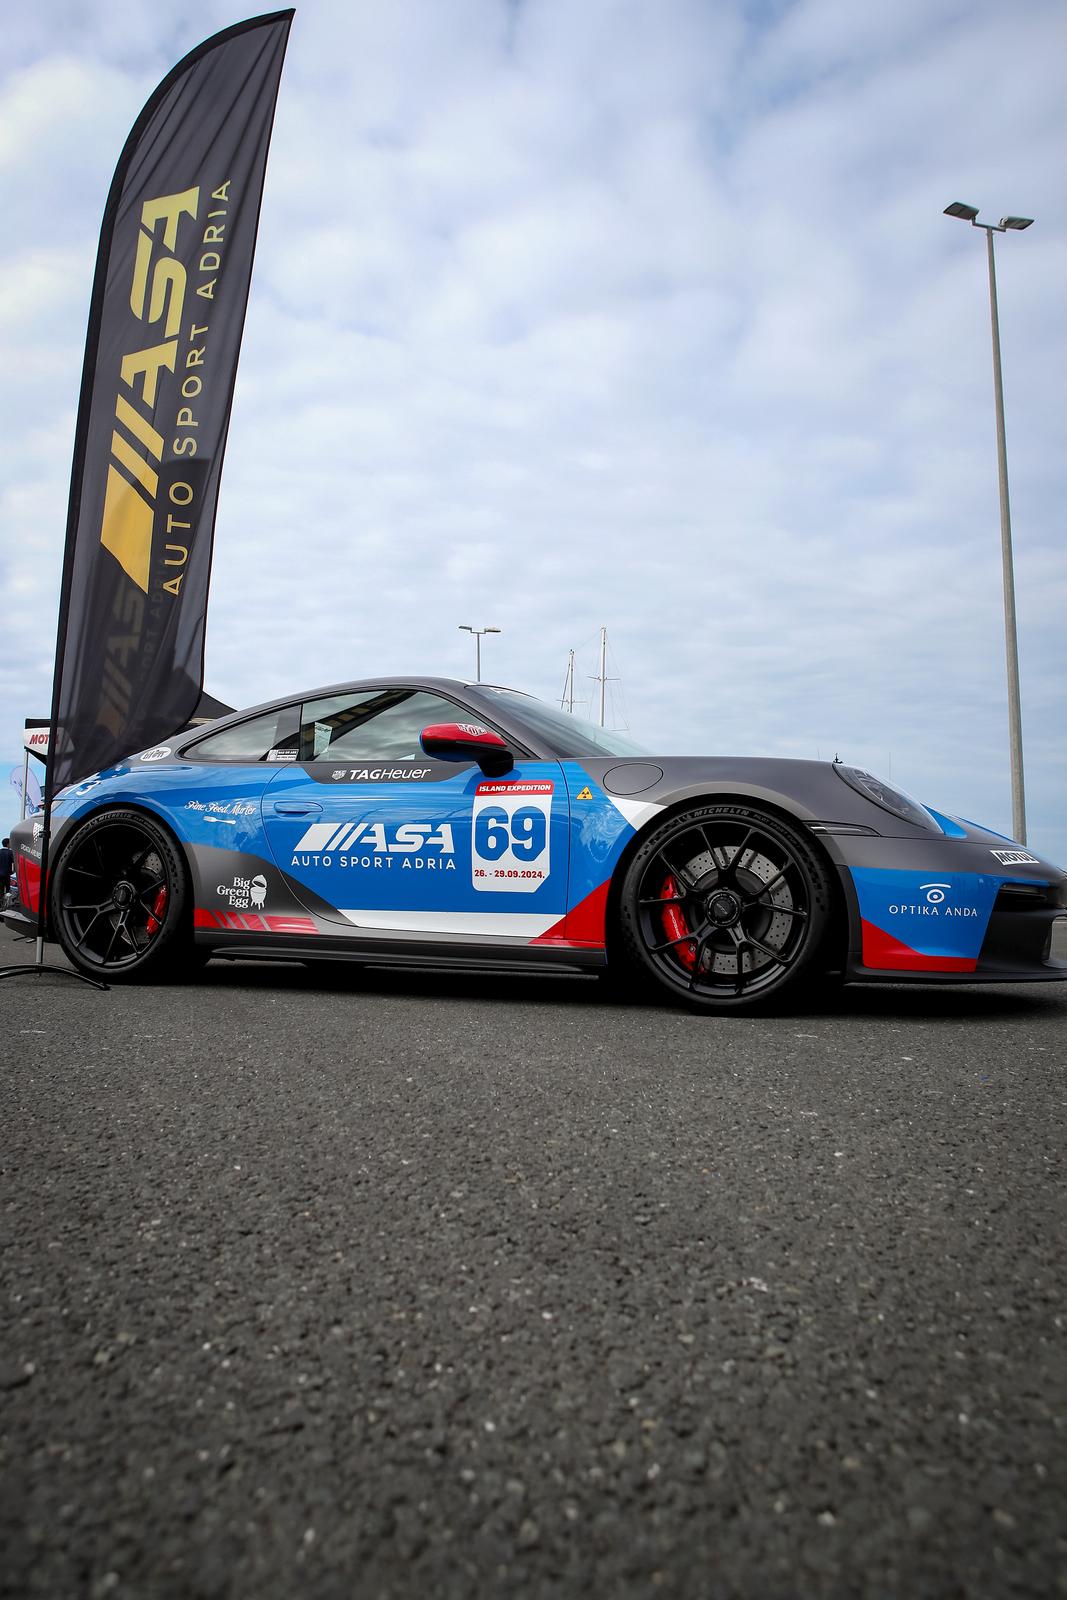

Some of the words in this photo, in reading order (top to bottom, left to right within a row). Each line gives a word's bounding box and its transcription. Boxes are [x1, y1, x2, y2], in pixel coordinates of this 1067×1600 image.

[196, 179, 231, 299] ADRIA
[172, 323, 209, 457] SPORT
[162, 481, 194, 596] AUTO
[29, 734, 51, 745] MOT
[694, 806, 750, 817] MICHELIN
[359, 822, 455, 853] ASA
[474, 805, 547, 862] 69
[291, 855, 332, 867] AUTO
[340, 856, 394, 868] SPORT
[402, 857, 456, 870] ADRIA
[995, 851, 1036, 863] MOTUL
[474, 869, 487, 877] 26.
[494, 870, 545, 879] 29.09.2024.
[233, 876, 250, 890] Big
[216, 885, 250, 897] Green
[229, 896, 249, 909] Egg
[888, 905, 939, 916] OPTIKA
[945, 906, 978, 917] ANDA
